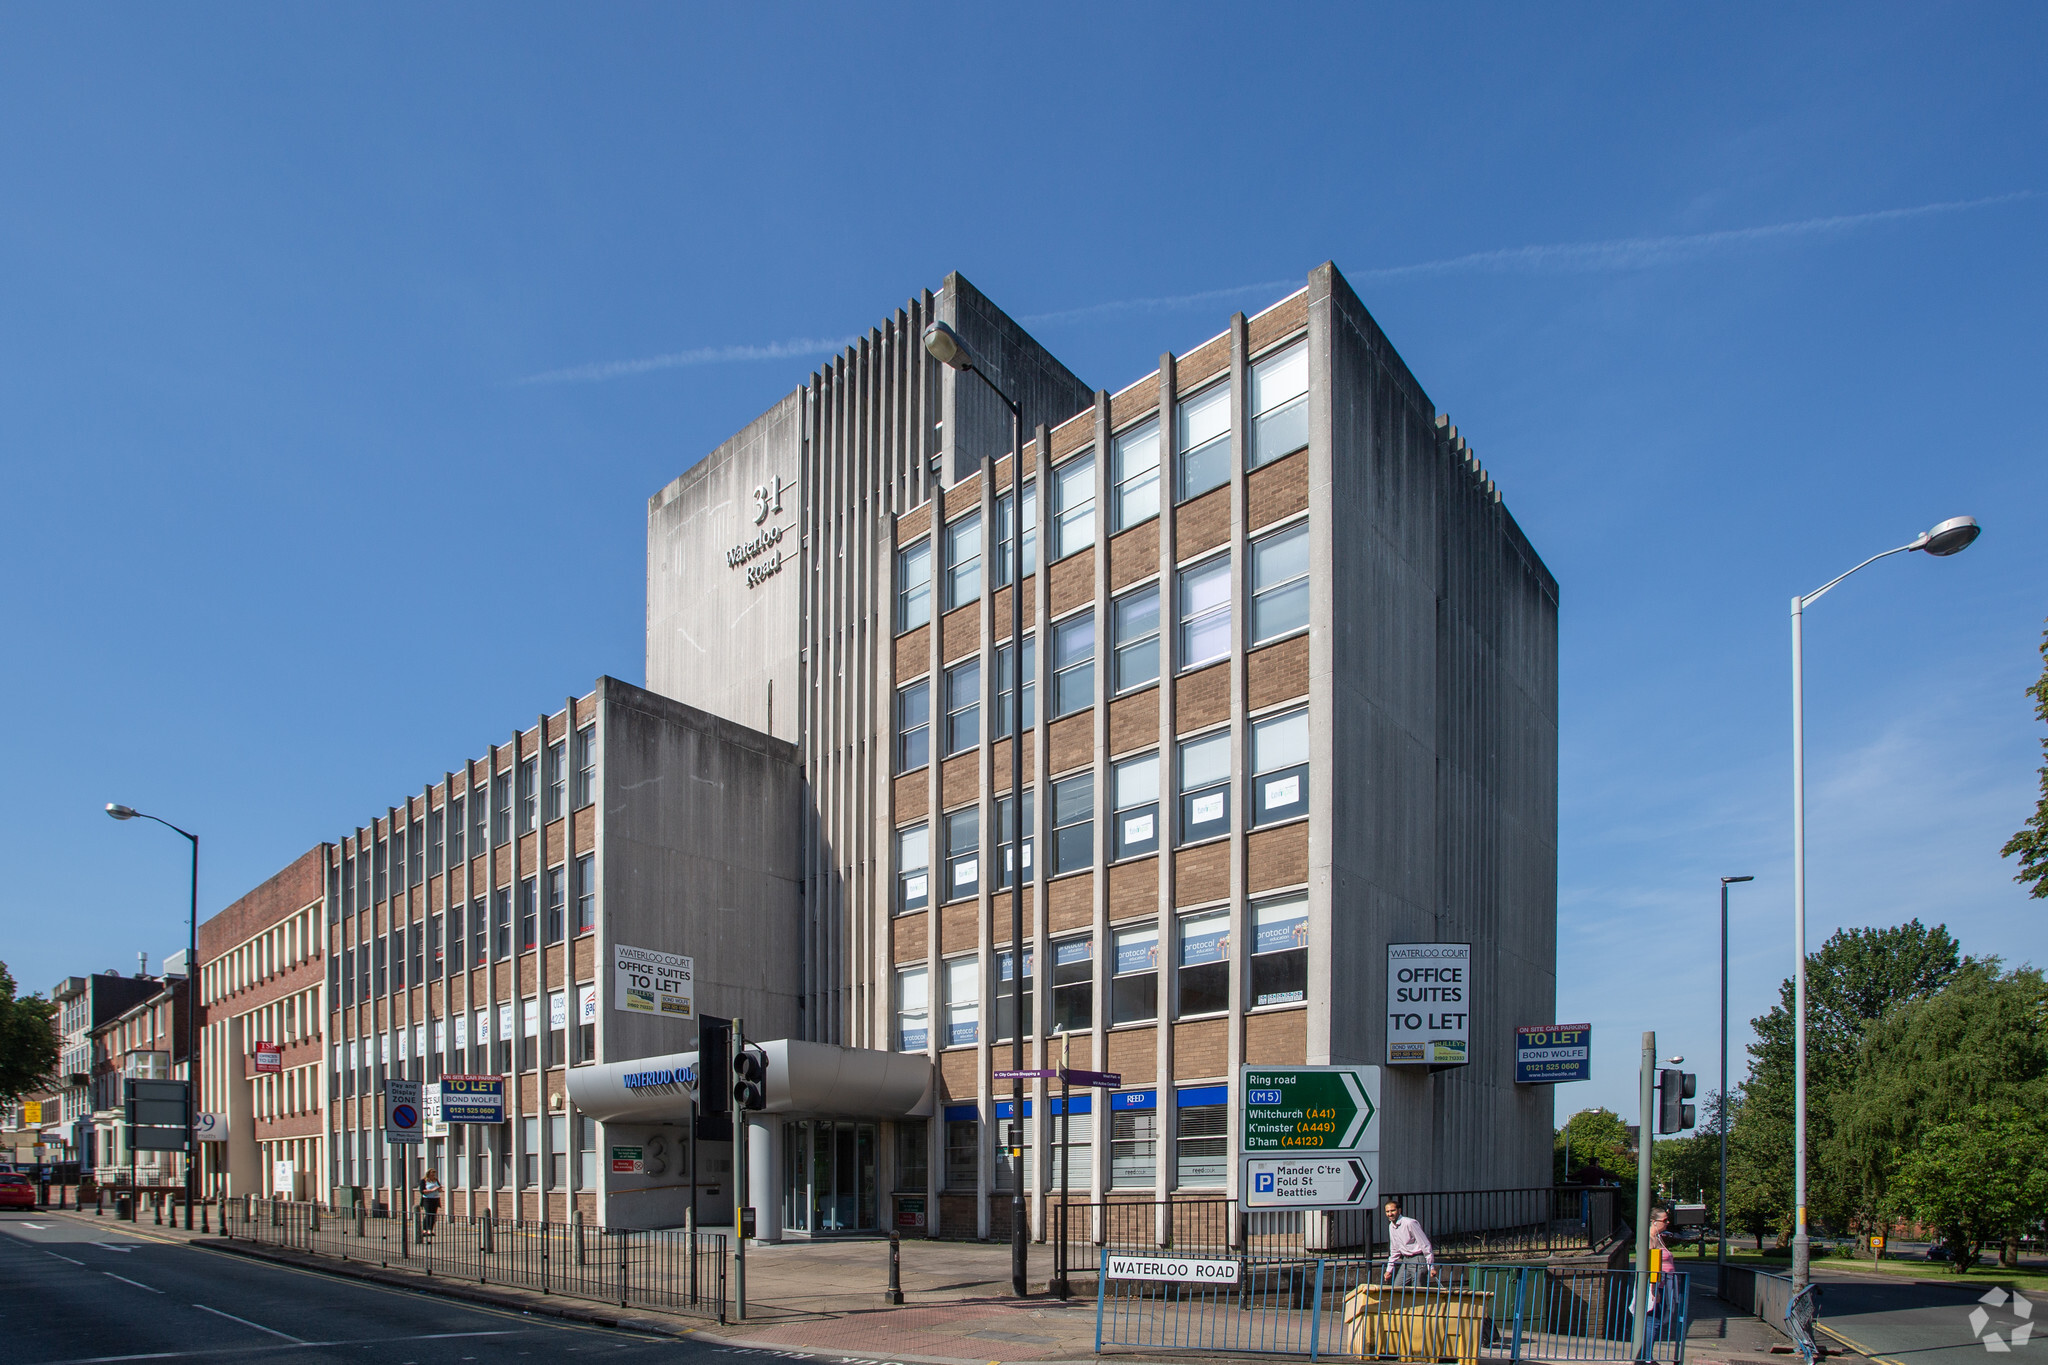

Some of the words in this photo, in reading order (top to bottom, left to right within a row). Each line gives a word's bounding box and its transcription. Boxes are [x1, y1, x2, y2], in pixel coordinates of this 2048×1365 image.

[752, 474, 782, 525] 31
[725, 525, 781, 568] Waterloo
[745, 549, 781, 588] Road
[618, 947, 663, 963] WATERLOO
[664, 955, 691, 968] COURT
[1391, 949, 1439, 958] WATERLOO
[1441, 949, 1468, 958] COURT
[618, 960, 654, 974] OFFICE
[657, 967, 691, 981] SUITES
[1397, 968, 1462, 983] OFFICE
[629, 973, 651, 989] TO
[655, 978, 682, 993] LET
[1397, 987, 1462, 1002] SUITES
[1390, 1013, 1422, 1030] TO
[1428, 1013, 1467, 1030] LET
[1560, 1023, 1589, 1031] PARKING
[1525, 1032, 1547, 1045] TO
[1552, 1031, 1582, 1044] LET
[1522, 1051, 1549, 1059] BOND
[1550, 1049, 1584, 1058] WOLFE
[1546, 1063, 1560, 1071] 525
[1561, 1062, 1580, 1070] 0600
[623, 1069, 671, 1088] WATERLOO
[674, 1067, 697, 1083] COU
[1249, 1075, 1271, 1086] Ring
[1274, 1075, 1297, 1084] road
[447, 1080, 467, 1091] TO
[471, 1081, 496, 1092] LET
[392, 1095, 417, 1103] ZONE
[470, 1096, 498, 1104] WOLFE
[1126, 1094, 1145, 1103] REED
[1249, 1109, 1303, 1119] Whitchurch
[1306, 1108, 1336, 1119] (A41)
[1249, 1123, 1294, 1133] K'minster
[1296, 1122, 1336, 1133] (A449)
[1249, 1137, 1278, 1147] B'ham
[1281, 1135, 1324, 1147] (A4123)
[1277, 1166, 1314, 1175] Mander
[1317, 1165, 1341, 1174] C'tre
[1277, 1177, 1298, 1186] Fold
[1301, 1176, 1313, 1185] St
[1277, 1188, 1318, 1197] Beatties
[1113, 1261, 1188, 1276] WATERLOO
[1195, 1264, 1235, 1278] ROAD
